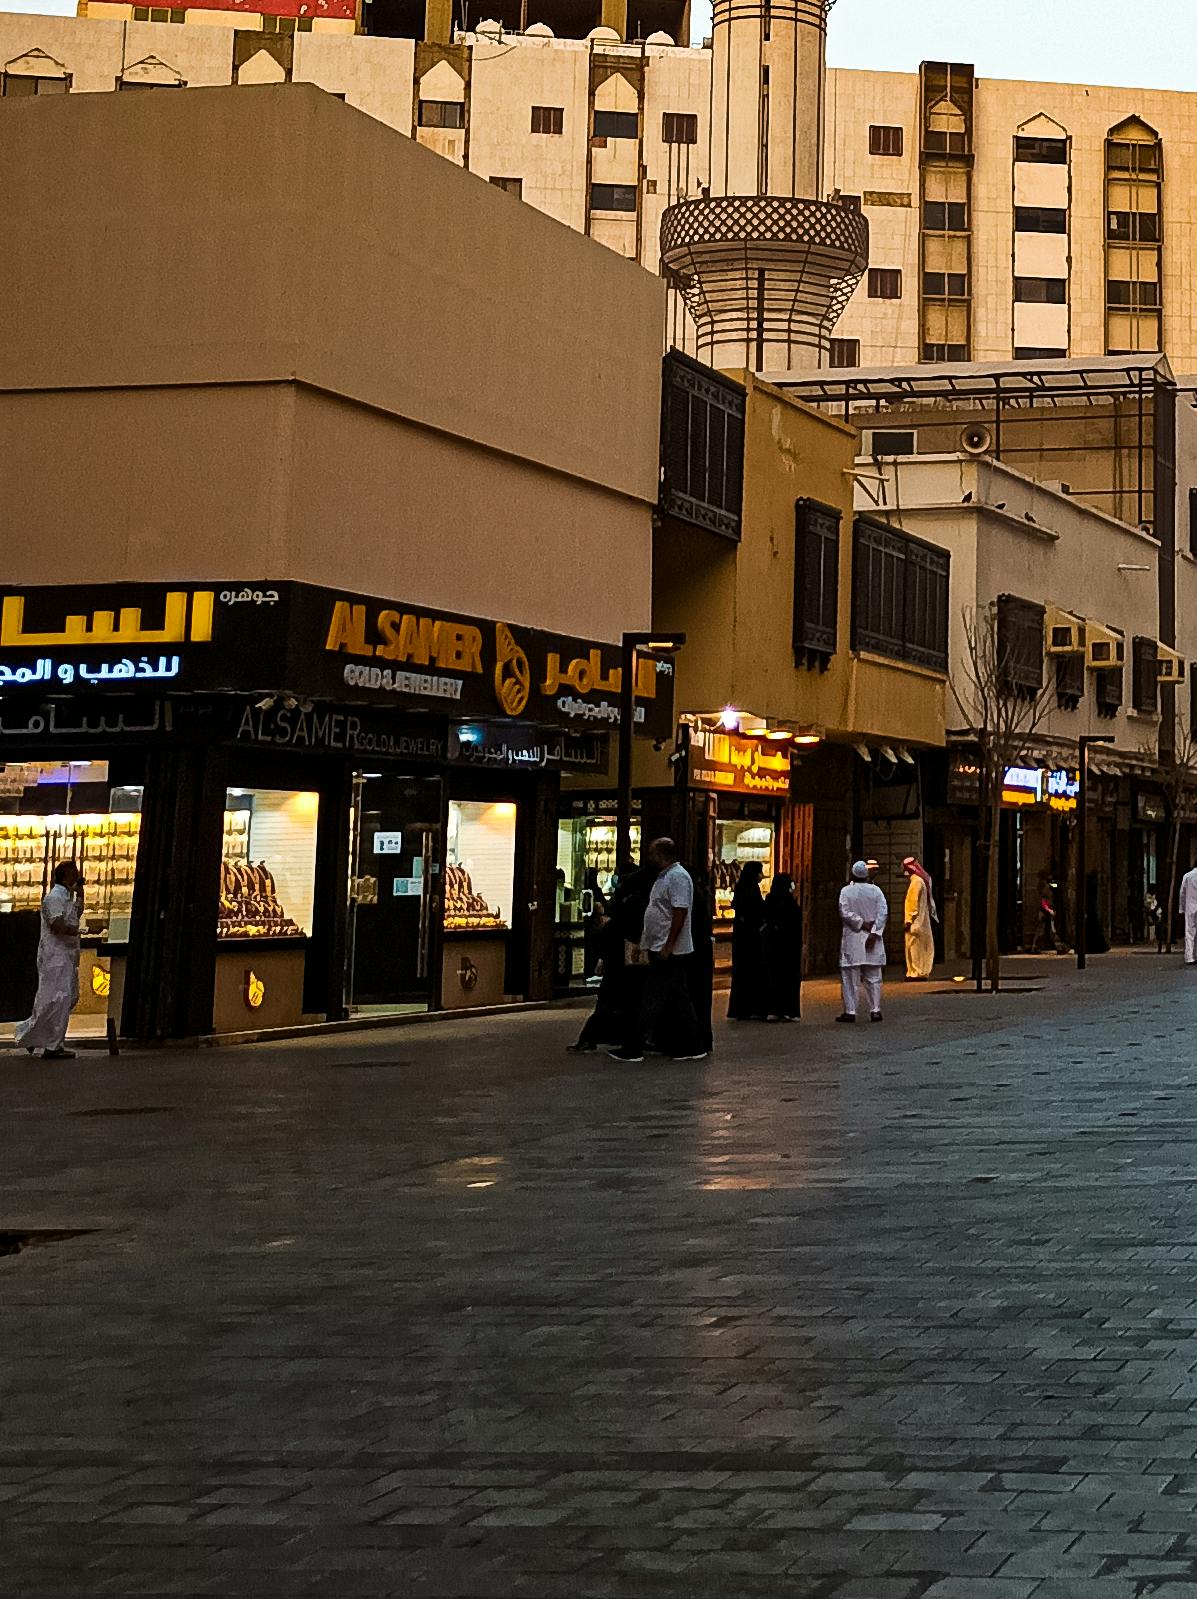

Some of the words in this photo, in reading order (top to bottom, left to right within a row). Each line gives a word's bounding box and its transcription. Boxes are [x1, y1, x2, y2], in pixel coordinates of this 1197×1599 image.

[0, 591, 215, 646] السا
[79, 656, 180, 685] للذهب
[343, 663, 382, 689] GOLD
[0, 699, 173, 734] السام
